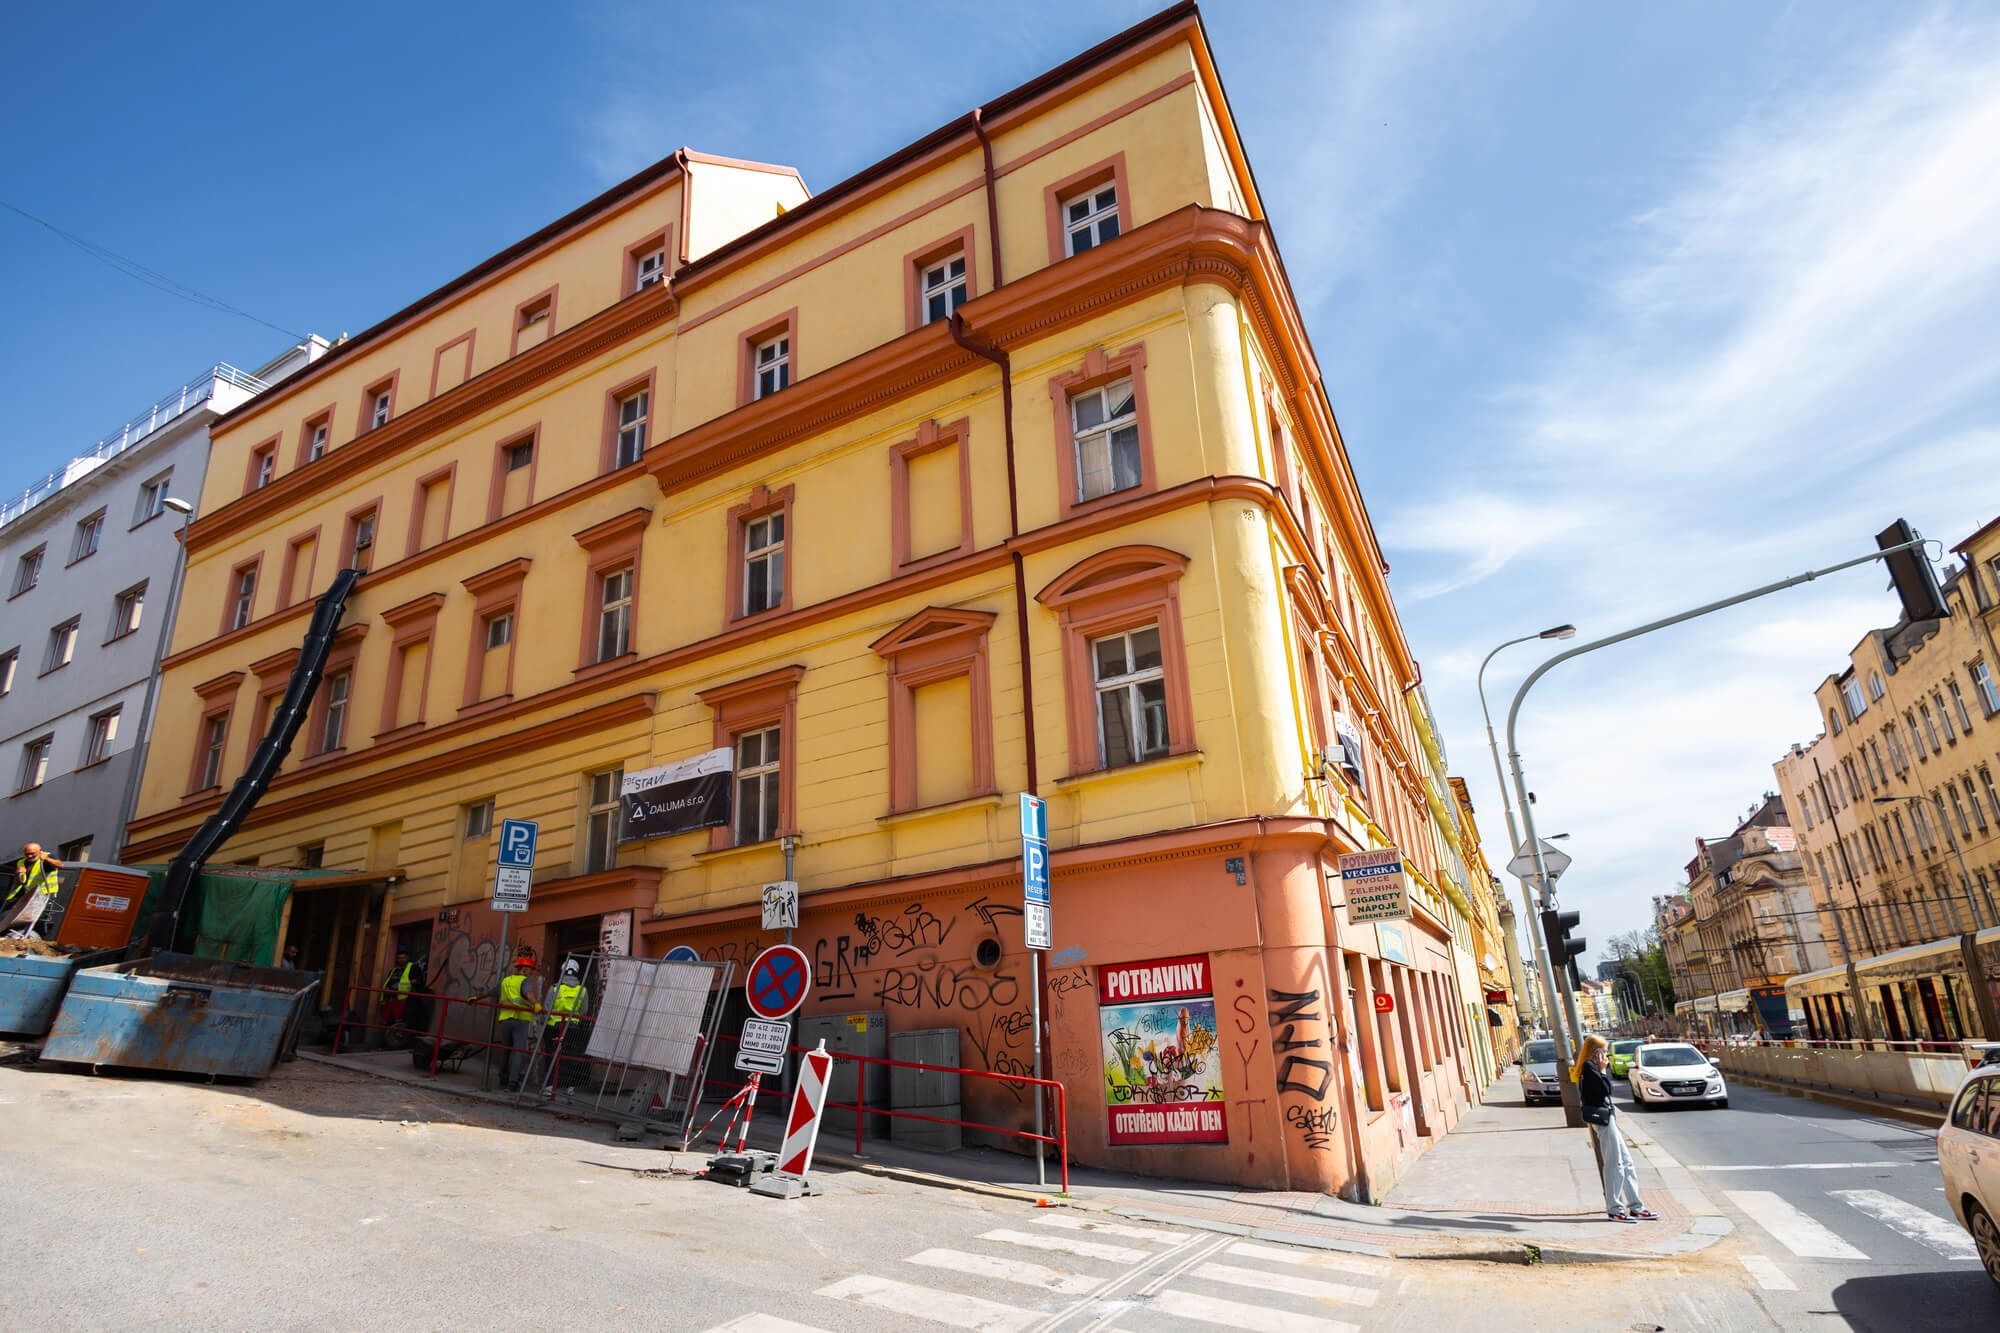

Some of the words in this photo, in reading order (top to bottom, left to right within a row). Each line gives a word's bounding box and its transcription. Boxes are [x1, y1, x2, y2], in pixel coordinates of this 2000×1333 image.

[649, 799, 686, 815] DALUMA
[686, 795, 705, 806] s.r.o.
[508, 825, 529, 852] P
[1029, 847, 1044, 881] P
[1342, 850, 1396, 869] POTRAVINY
[1345, 865, 1398, 879] VEČERKA
[1356, 874, 1390, 885] OVOCE
[1349, 883, 1399, 896] ZELENINA
[1350, 891, 1401, 905] CIGARETY
[1357, 901, 1398, 913] NÁPOJE
[1107, 962, 1204, 998] POTRAVINY
[744, 1040, 760, 1048] MIMO
[760, 1042, 781, 1051] STAVBU
[1115, 1108, 1166, 1135] OTEVŘENO
[1166, 1106, 1200, 1132] KAŽDÝ
[1200, 1109, 1223, 1131] DEN
